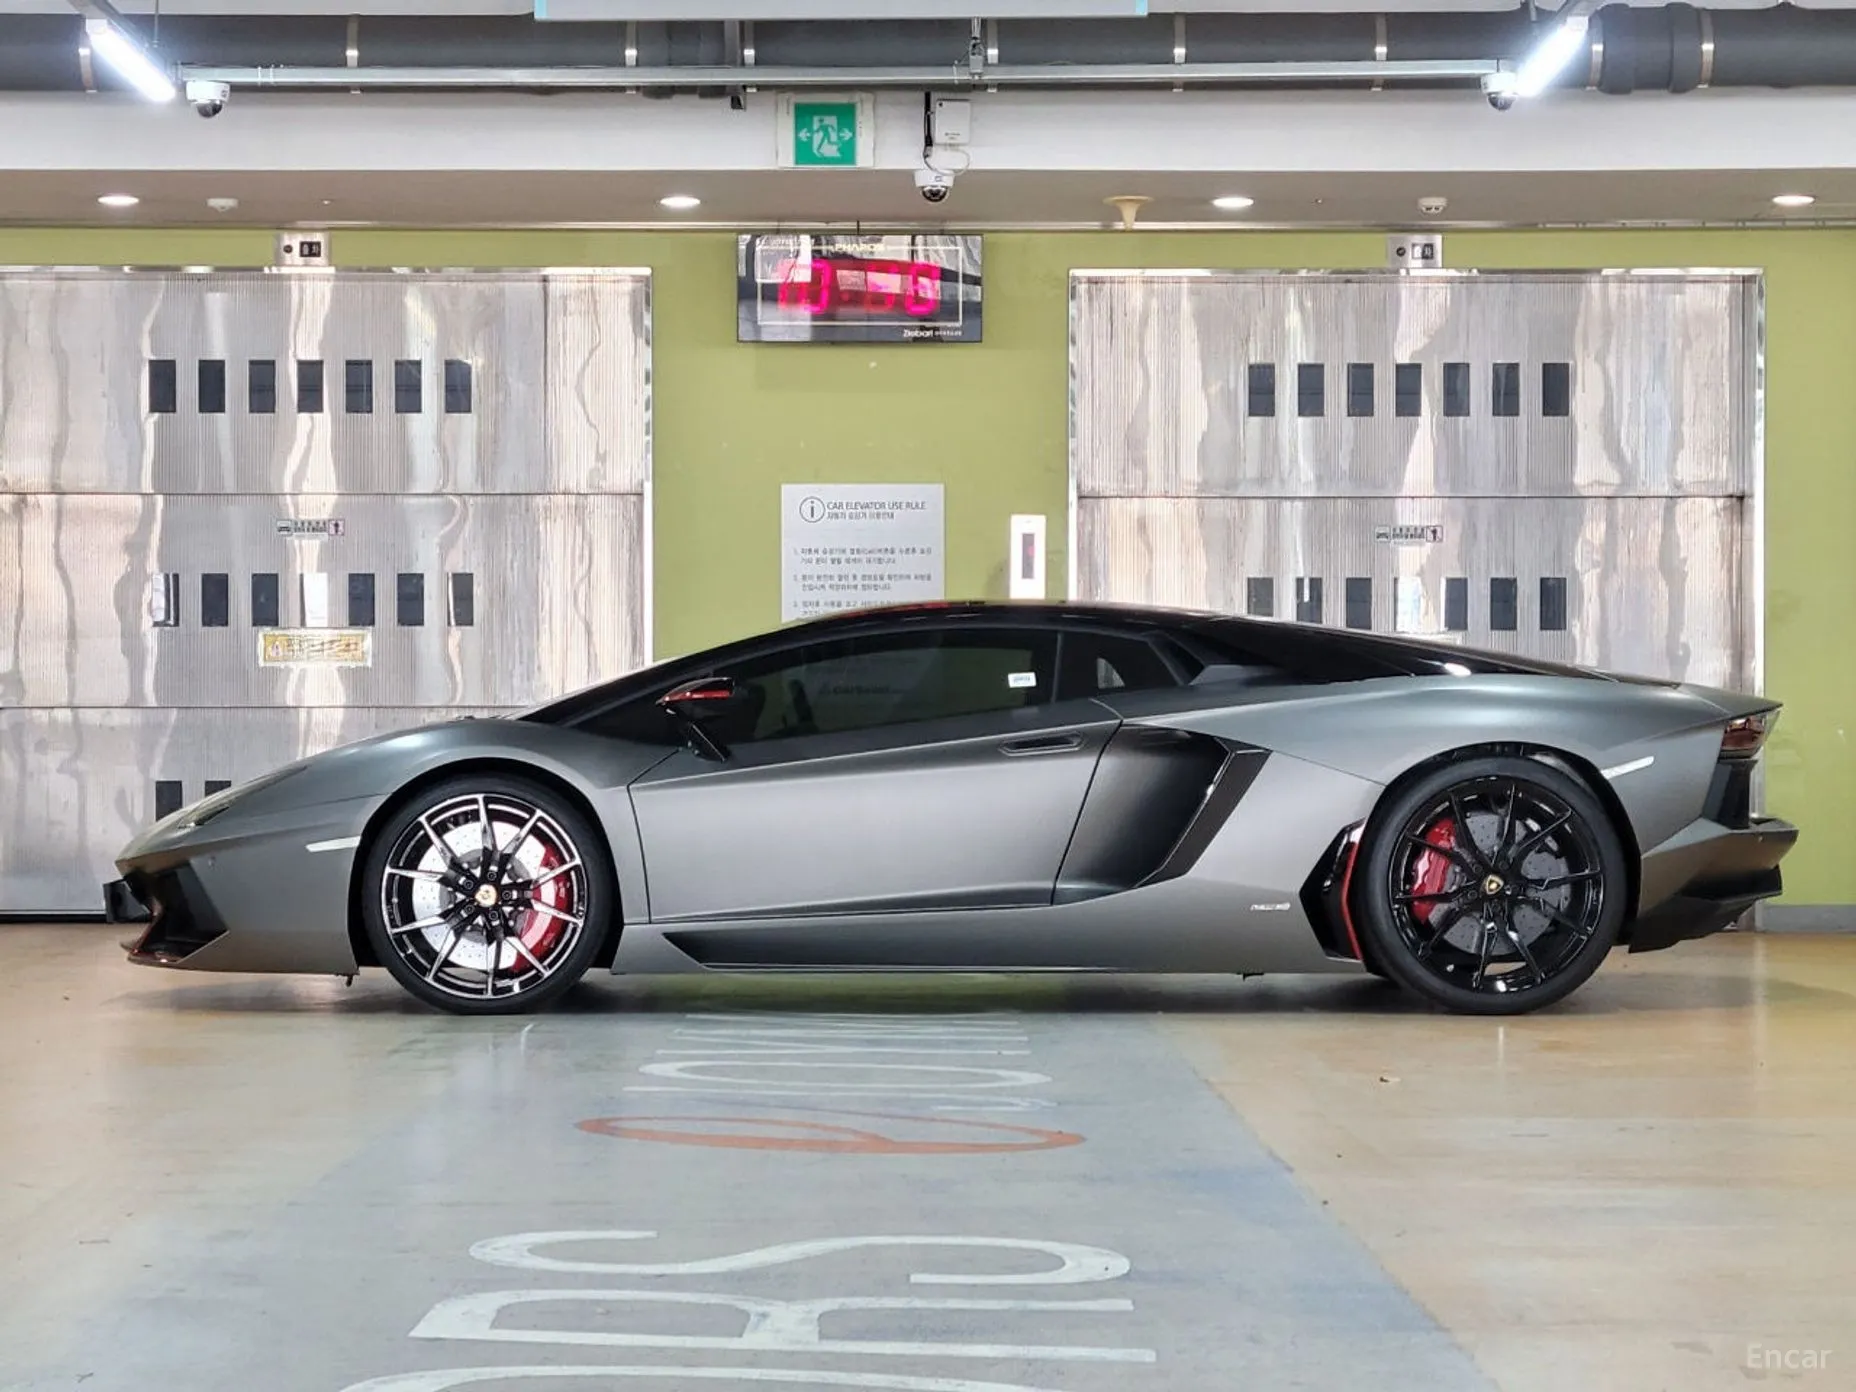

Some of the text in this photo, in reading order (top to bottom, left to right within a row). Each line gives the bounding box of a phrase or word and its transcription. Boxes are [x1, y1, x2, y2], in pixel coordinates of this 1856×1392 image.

[826, 501, 926, 510] CAR ELEVATOR USE RULE
